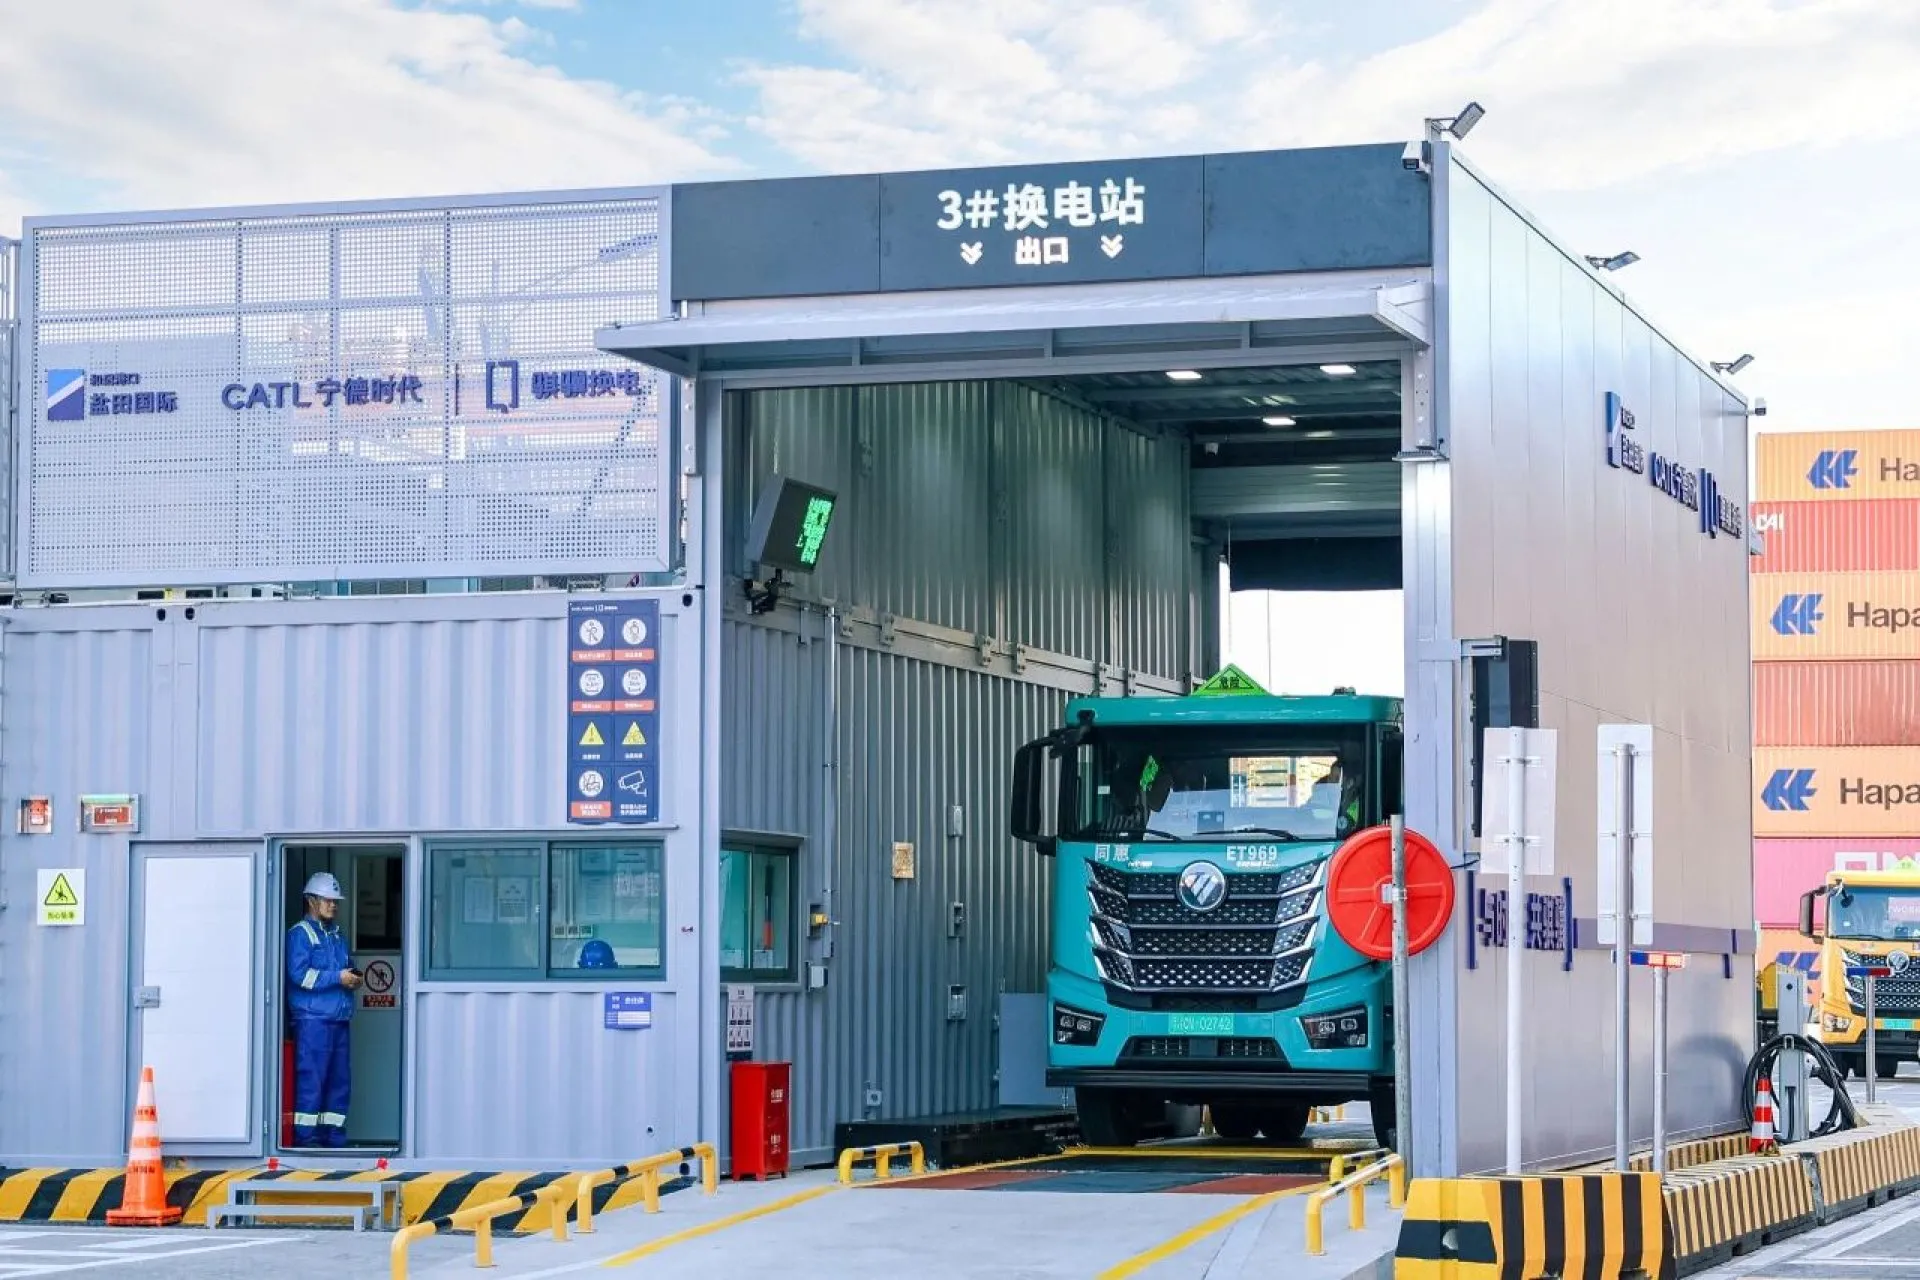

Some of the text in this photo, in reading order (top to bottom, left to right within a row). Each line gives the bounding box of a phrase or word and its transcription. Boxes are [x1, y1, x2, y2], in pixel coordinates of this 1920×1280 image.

[937, 177, 1145, 231] 3#换电站
[1015, 236, 1069, 265] 出口
[90, 390, 178, 416] 盐田国际
[221, 382, 312, 410] CATL
[315, 374, 424, 408] 宁德时代
[1226, 845, 1277, 861] ET969
